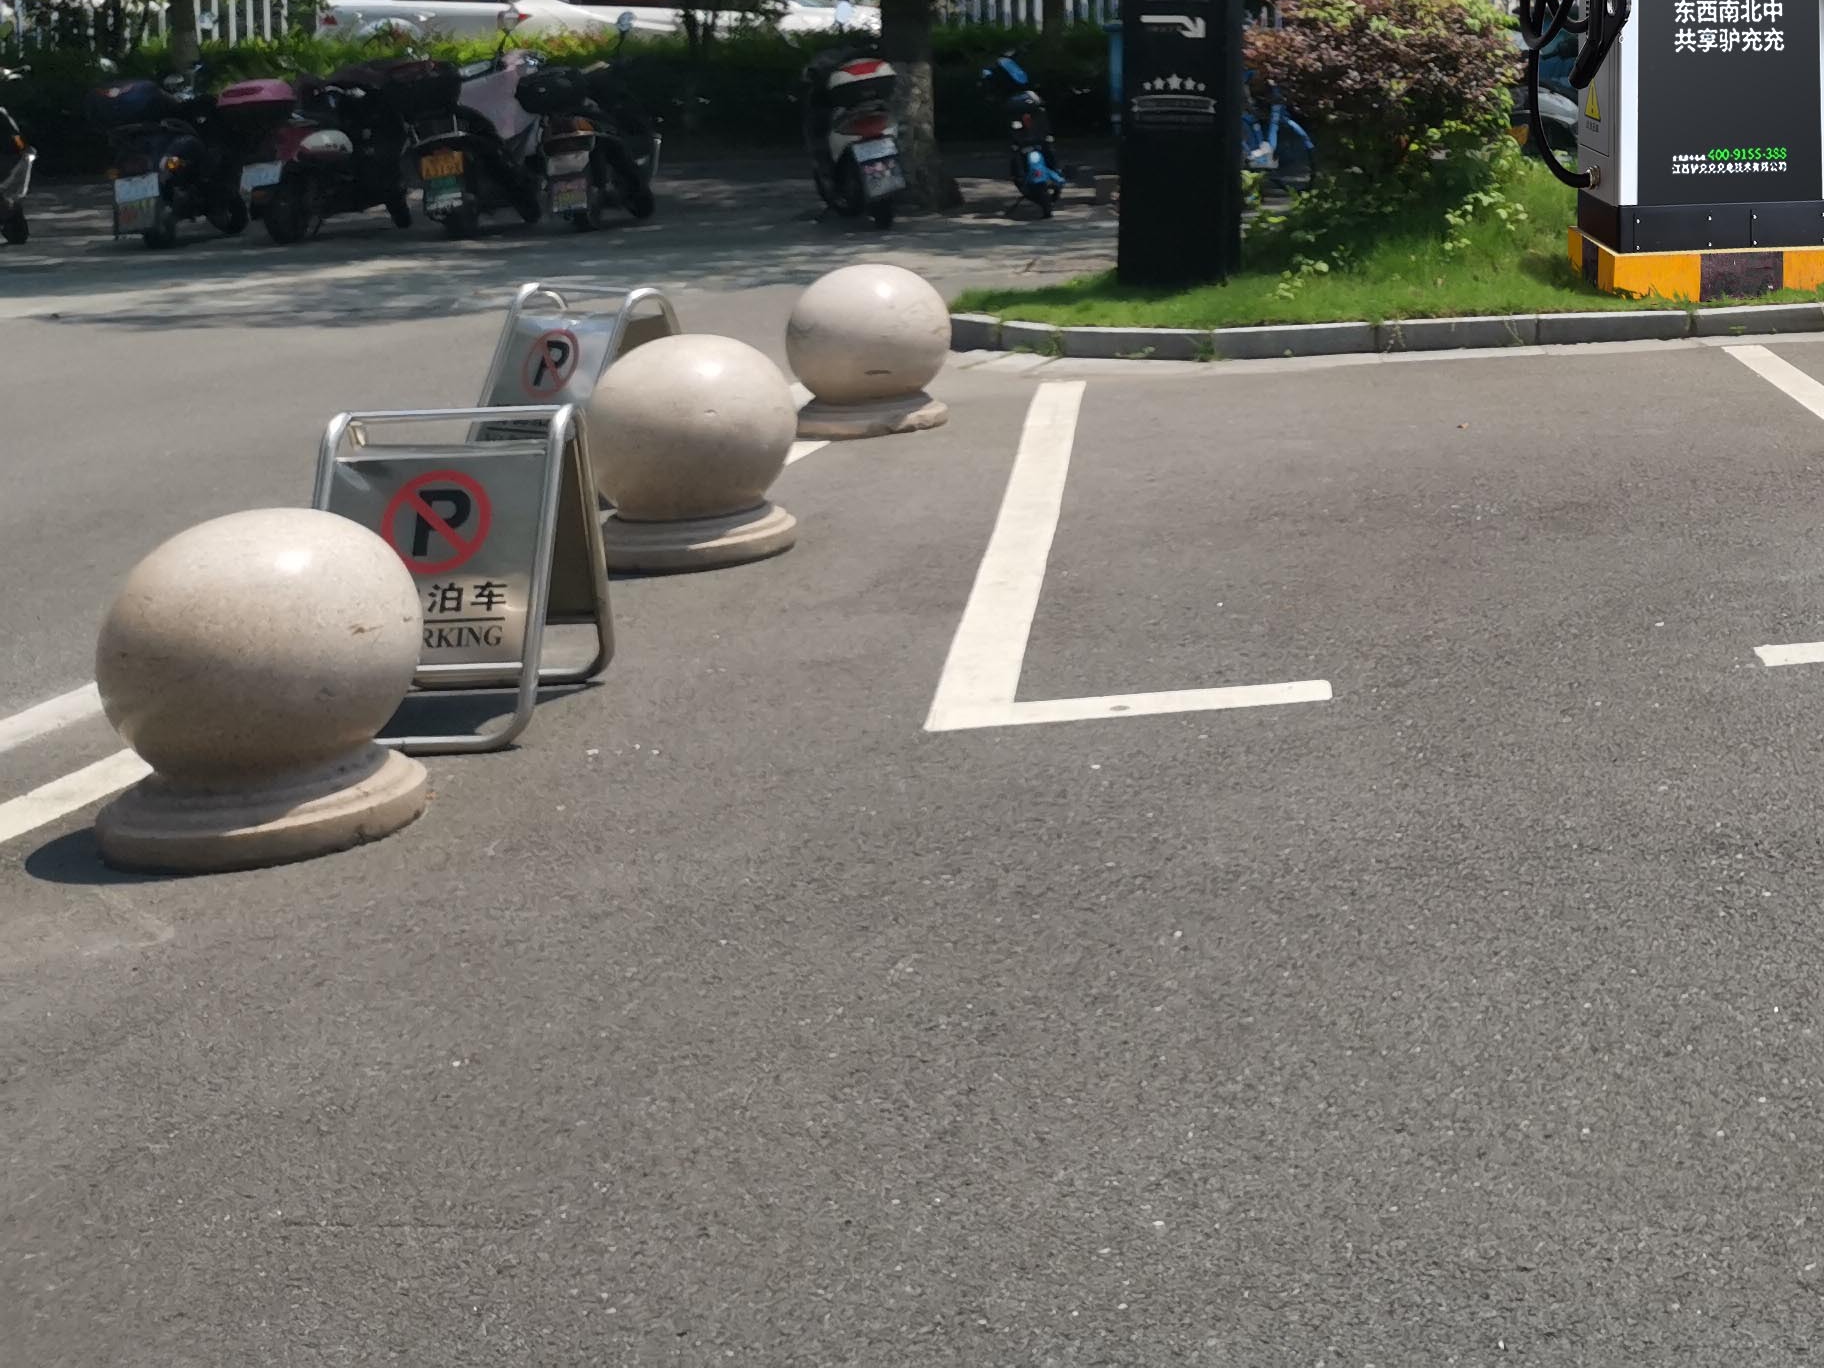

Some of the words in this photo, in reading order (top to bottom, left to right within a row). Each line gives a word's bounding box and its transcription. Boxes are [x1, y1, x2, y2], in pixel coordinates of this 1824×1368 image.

[1674, 28, 1785, 53] 共享驴充充
[412, 488, 472, 557] P
[418, 581, 508, 613] 泊车
[423, 625, 502, 648] RKING
